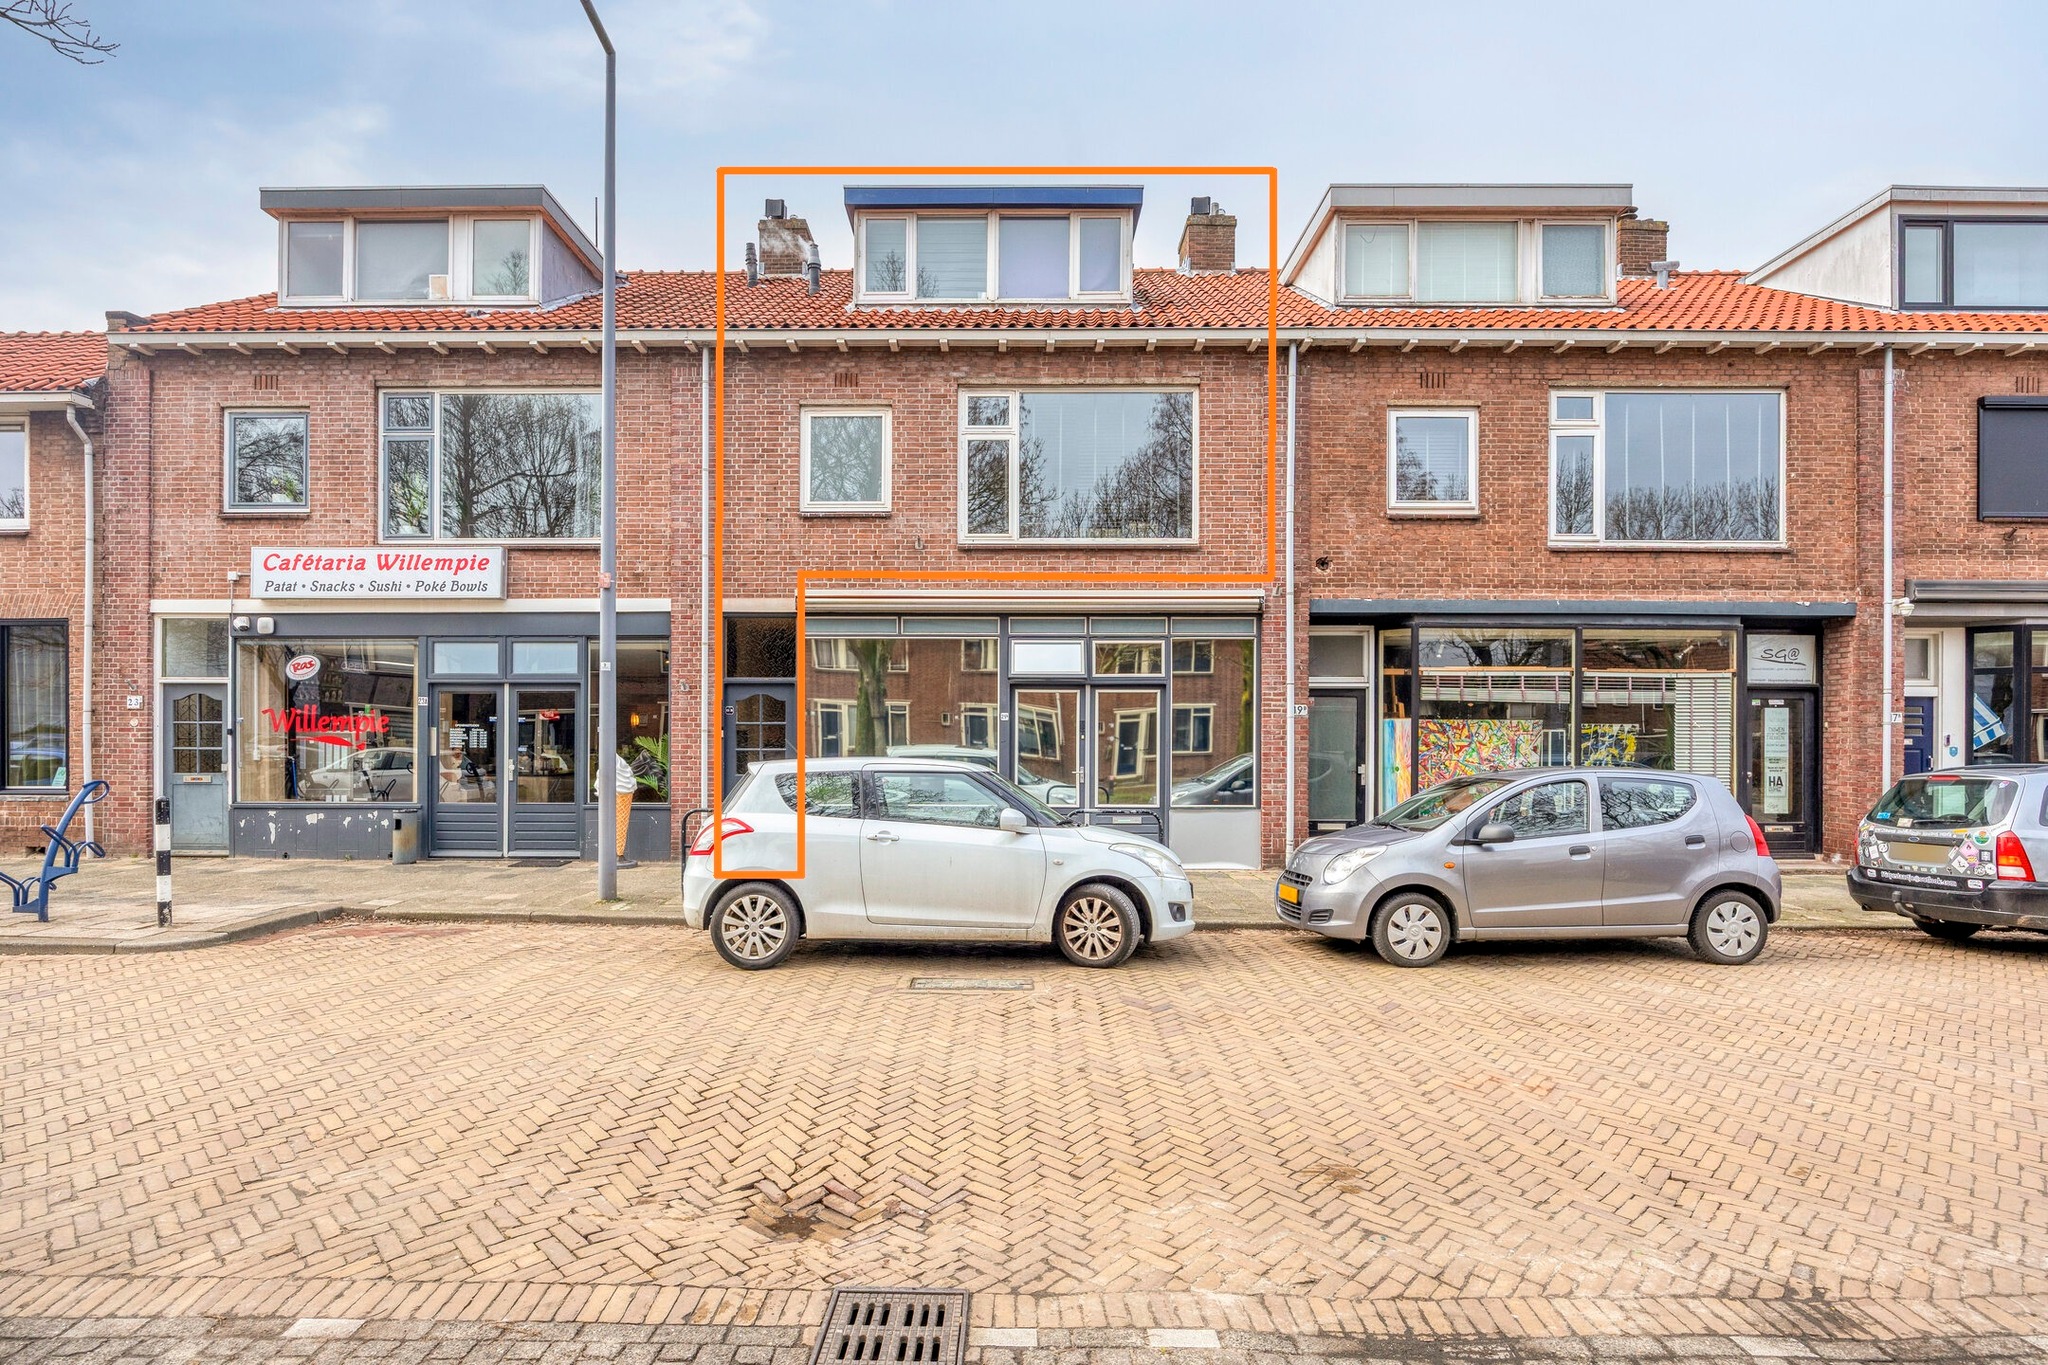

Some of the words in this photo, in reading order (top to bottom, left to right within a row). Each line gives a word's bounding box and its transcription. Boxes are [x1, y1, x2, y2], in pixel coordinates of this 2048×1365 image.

[263, 553, 366, 572] Cafétaria
[376, 553, 490, 576] Willempie
[264, 580, 298, 592] Patat
[309, 580, 356, 592] Snacks
[368, 580, 402, 592] Sushi
[415, 579, 447, 592] Poké
[450, 580, 488, 592] Bowls
[1760, 647, 1800, 662] SG@
[291, 659, 315, 673] Ras
[127, 698, 139, 706] 23
[261, 703, 390, 742] Willempie
